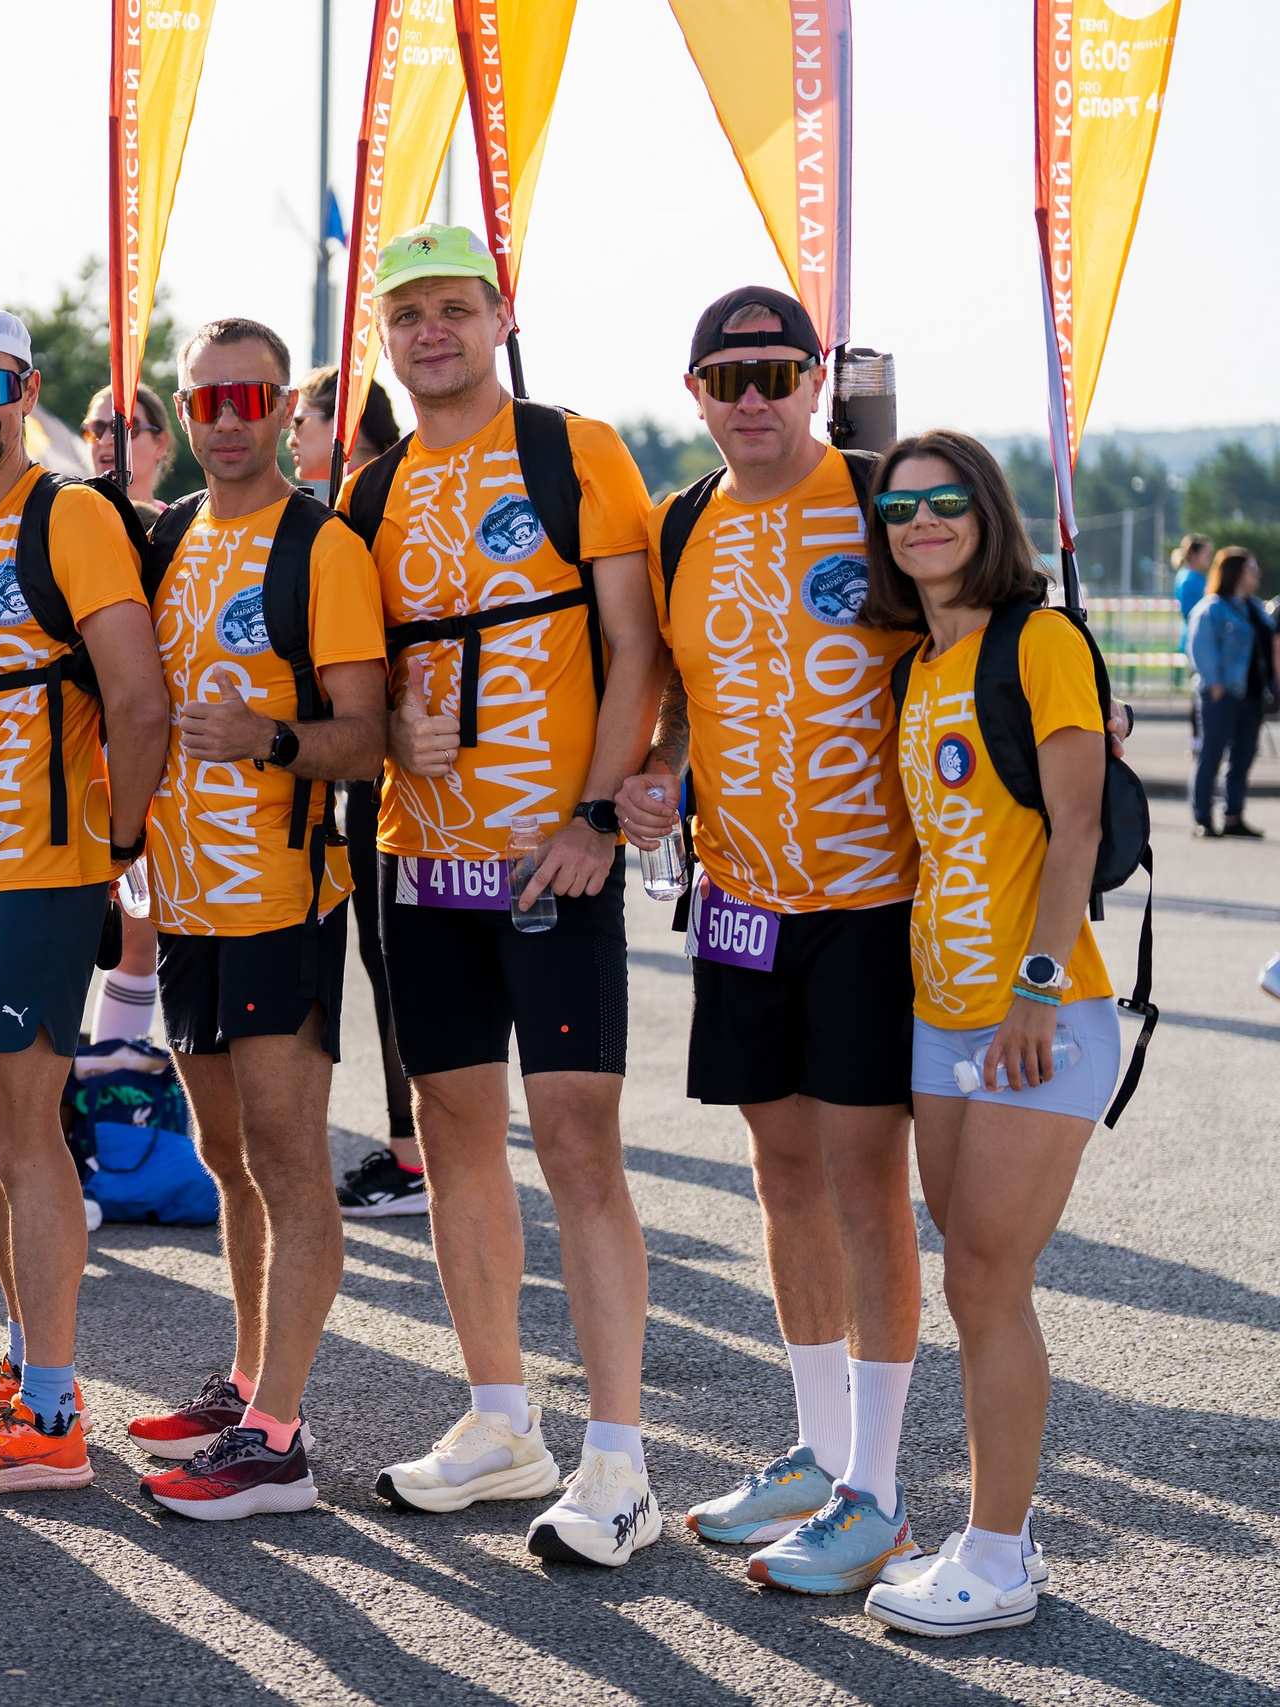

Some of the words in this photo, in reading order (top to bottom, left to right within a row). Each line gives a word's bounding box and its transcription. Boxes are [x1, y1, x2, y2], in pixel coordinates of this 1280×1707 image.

[1078, 18, 1108, 32] ТЕМП
[1080, 39, 1131, 72] 6:06
[1078, 81, 1101, 95] PRO
[1078, 96, 1140, 119] СПОРТ
[479, 0, 512, 254] КАЛУЖСКИ
[705, 513, 762, 796] КАЛУЖСКИЙ
[429, 859, 501, 897] 4169
[708, 907, 768, 956] 5050
